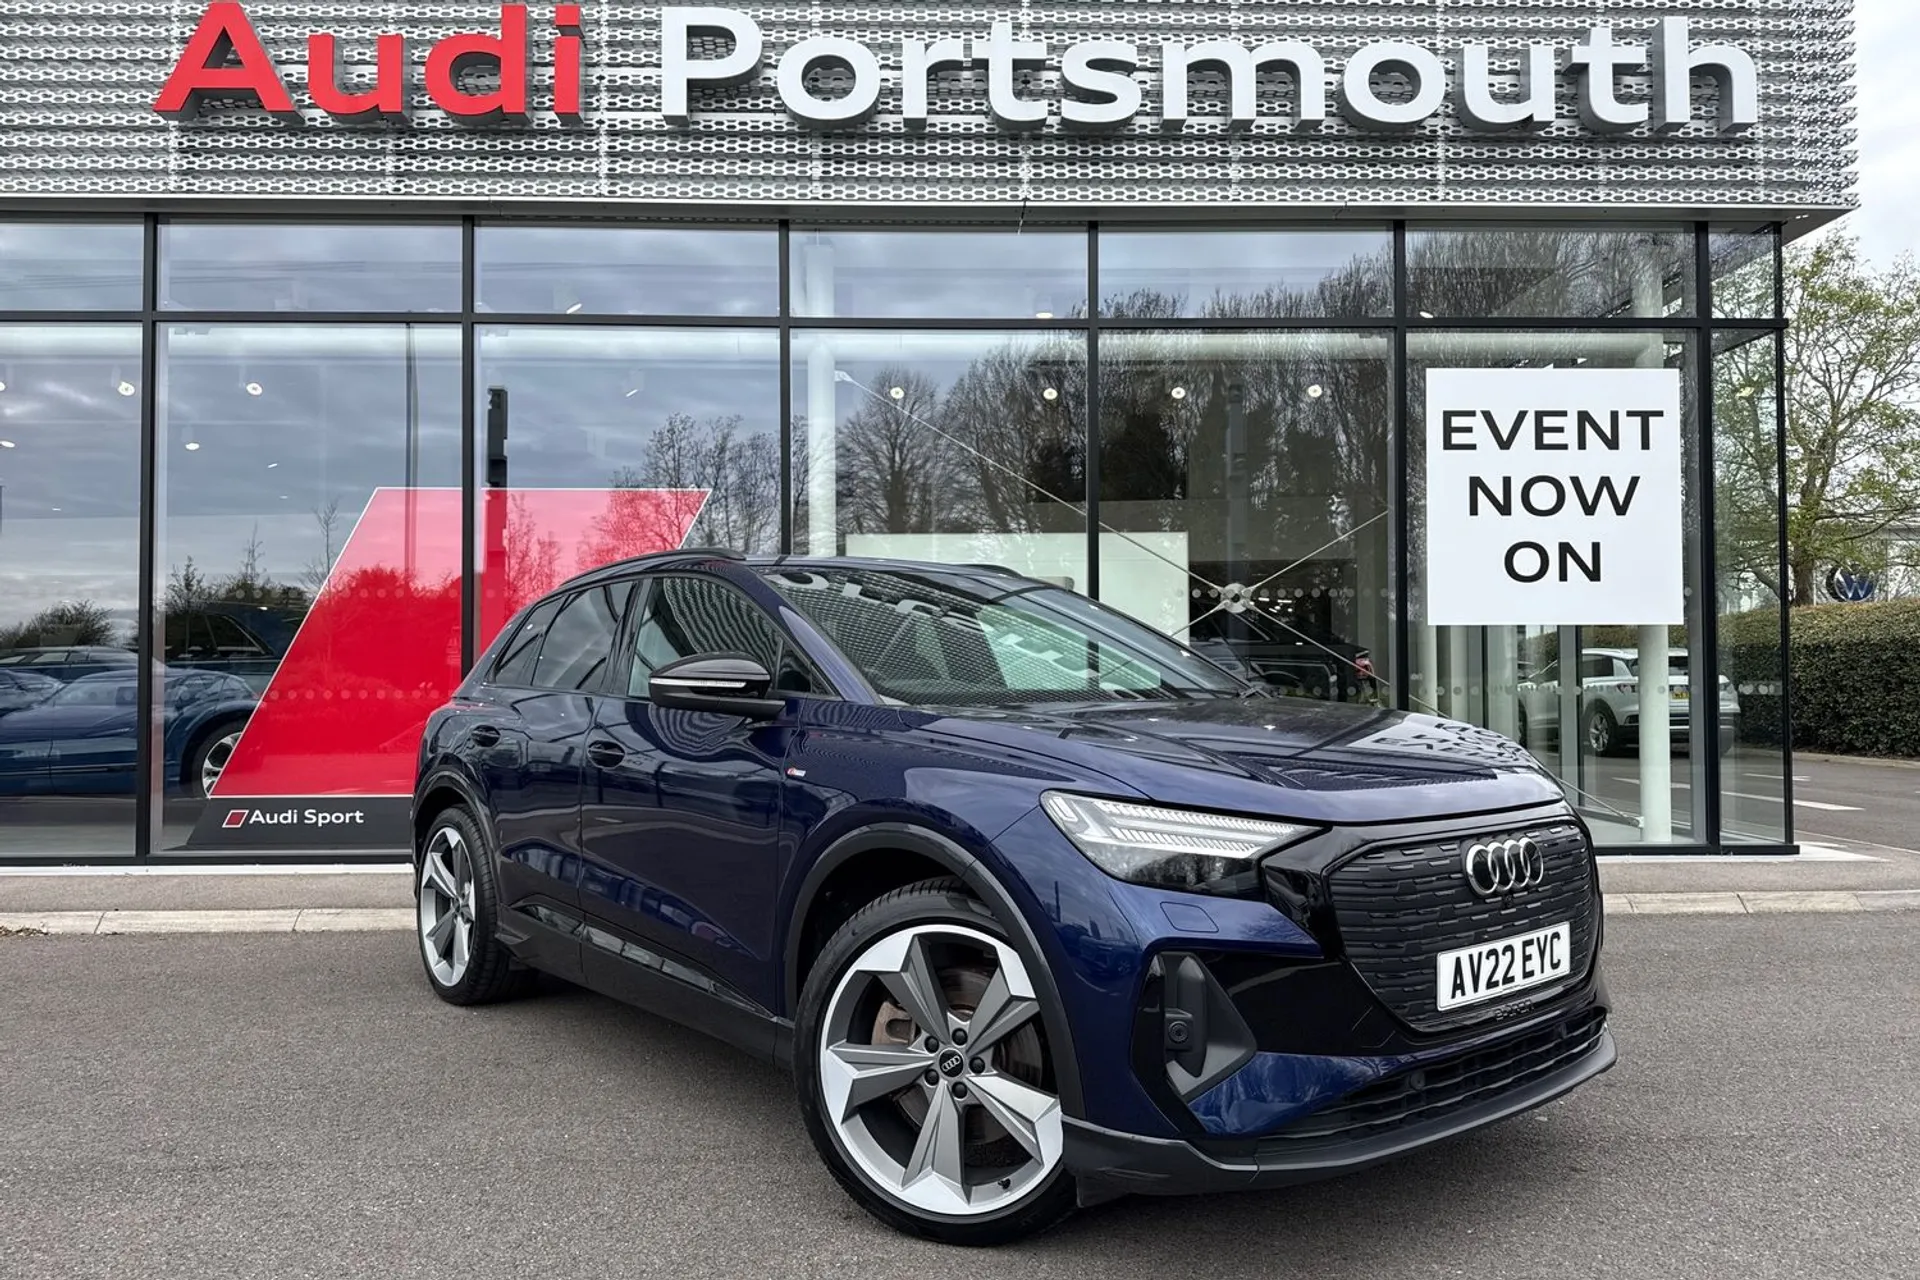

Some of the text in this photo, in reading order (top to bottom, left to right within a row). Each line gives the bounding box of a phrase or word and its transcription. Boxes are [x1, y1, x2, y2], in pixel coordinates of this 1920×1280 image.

[154, 1, 1762, 134] Audi Portsmouth
[1442, 410, 1664, 451] EVENT
[1468, 475, 1640, 517] NOW
[1504, 541, 1602, 583] ON
[249, 809, 364, 827] Audi Sport
[1451, 931, 1562, 999] AV22 EYC
